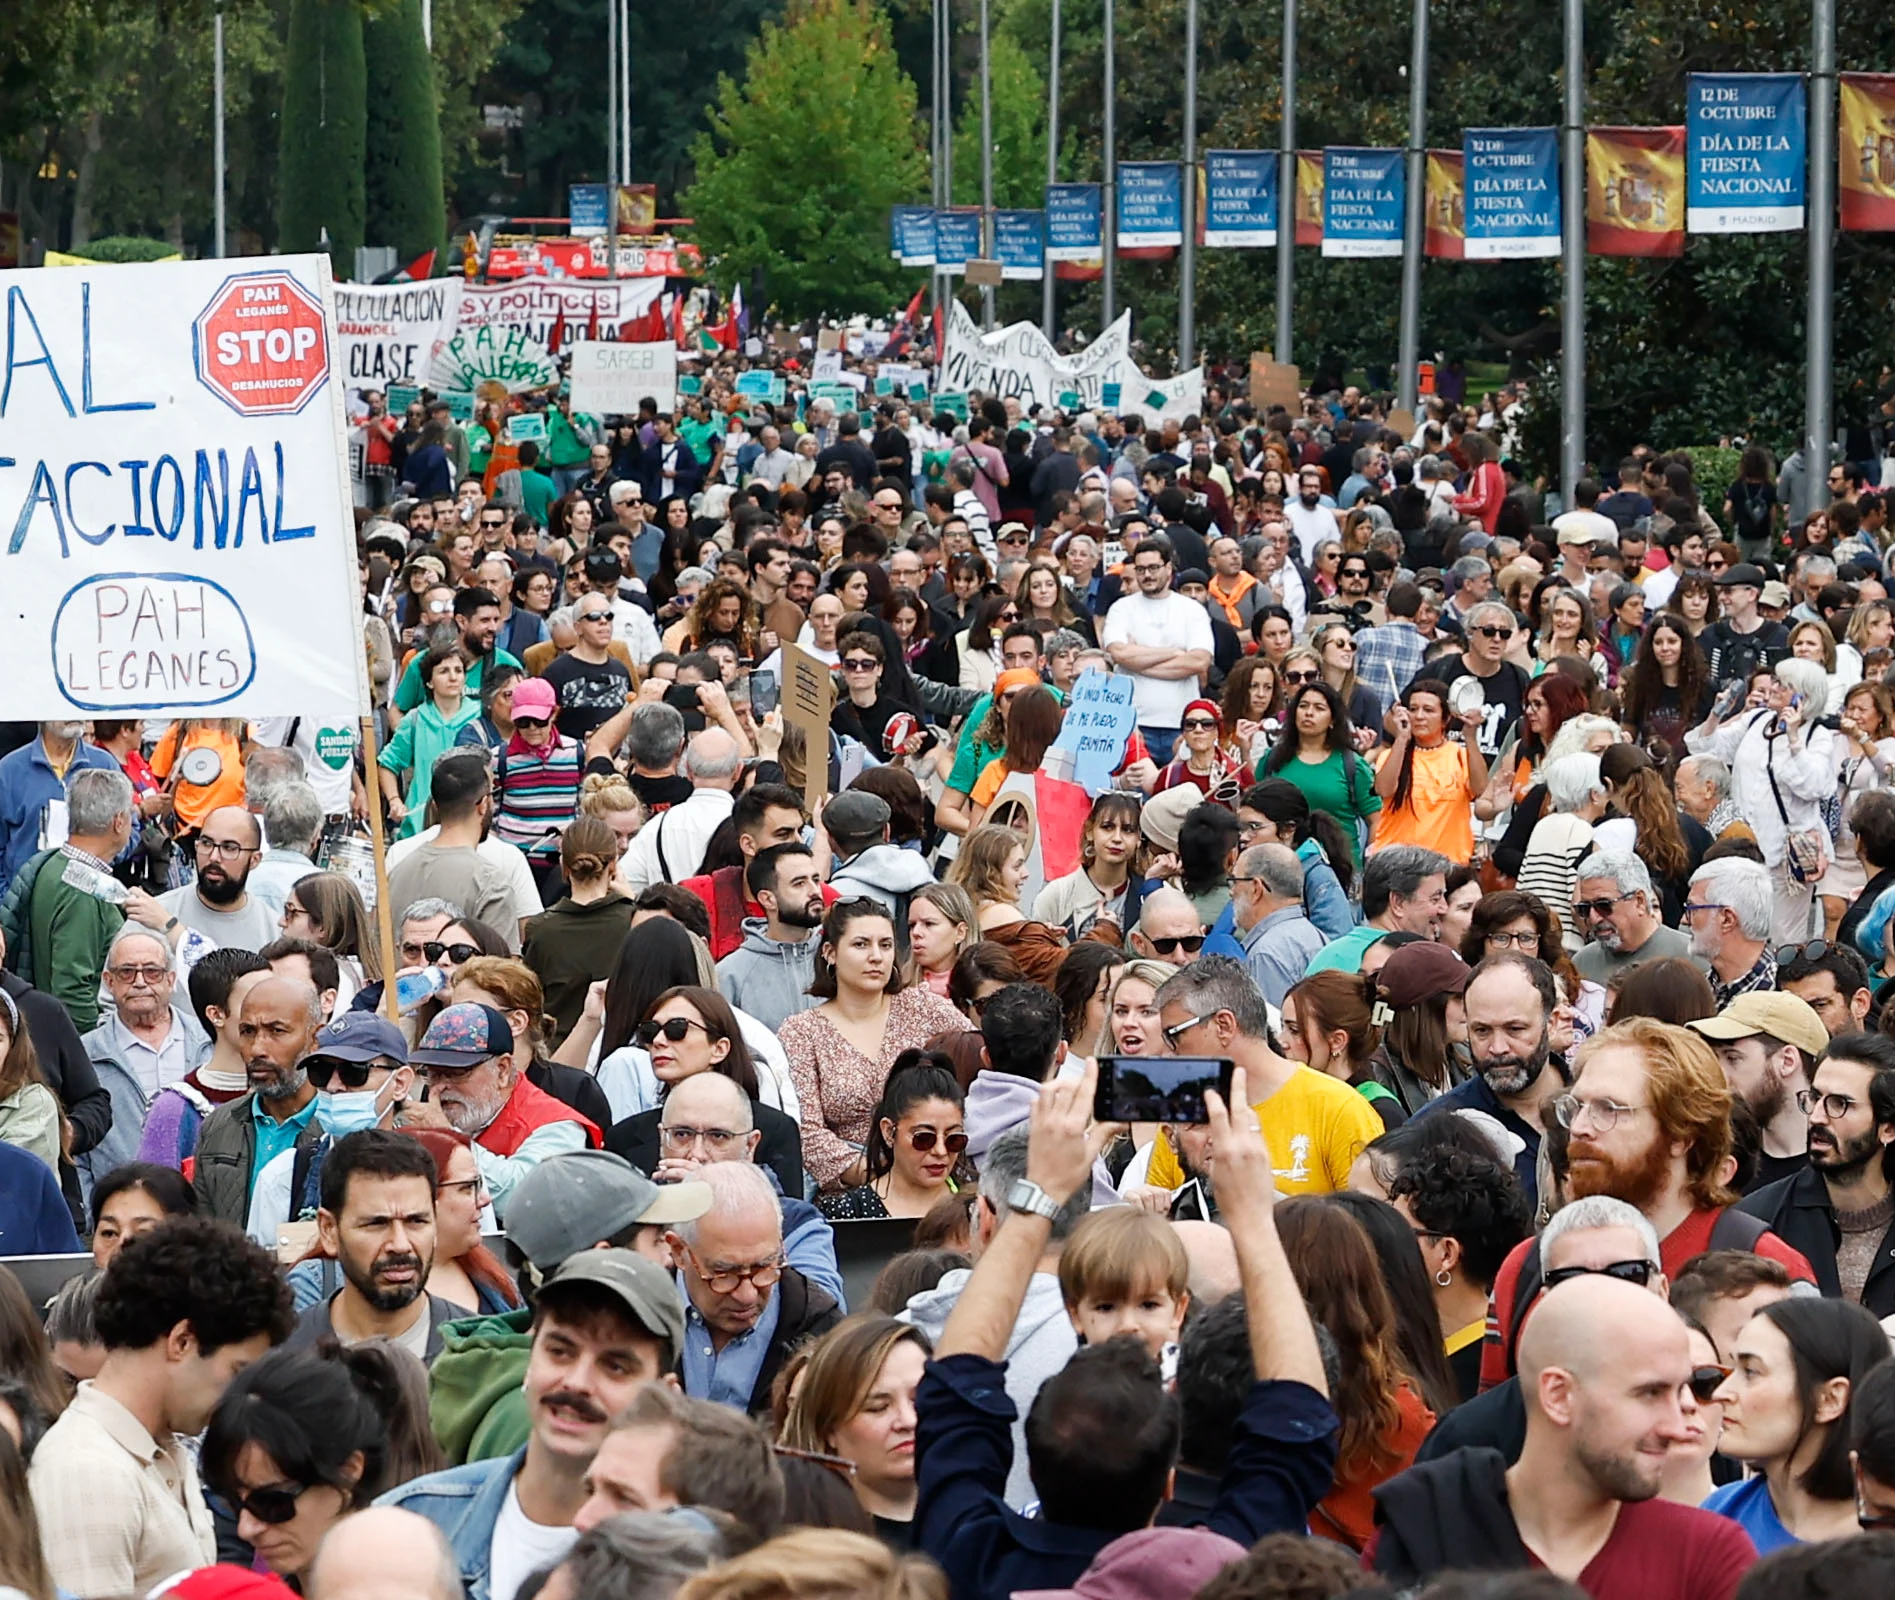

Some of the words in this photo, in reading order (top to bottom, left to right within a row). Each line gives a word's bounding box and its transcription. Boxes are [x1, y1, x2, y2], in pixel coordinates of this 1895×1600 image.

[1700, 88, 1713, 102] 12
[1717, 88, 1739, 101] DE
[1700, 105, 1776, 120] OCTUBRE
[1485, 140, 1503, 151] DE
[1700, 133, 1733, 152] DÍA
[1737, 136, 1763, 151] DE
[1766, 135, 1791, 151] LA
[1472, 154, 1535, 167] OCTUBRE
[1700, 157, 1762, 173] FIESTA
[1330, 169, 1385, 179] OCTUBRE
[1473, 177, 1500, 192] DÍA
[1503, 179, 1524, 191] DE
[1526, 178, 1547, 191] LA
[1700, 178, 1797, 194] NACIONAL
[1356, 189, 1374, 201] DE
[1375, 190, 1394, 201] LA
[1213, 201, 1250, 211] FIESTA
[1330, 204, 1374, 216] FIESTA
[1473, 197, 1524, 210] FIESTA
[1123, 216, 1175, 226] NACIONAL
[1213, 213, 1272, 223] NACIONAL
[1330, 219, 1398, 231] NACIONAL
[1472, 213, 1554, 227] NACIONAL
[1732, 216, 1776, 225] MADRID
[243, 286, 280, 302] PAH
[235, 304, 289, 318] LEGANÉS
[481, 297, 495, 313] Y
[216, 327, 317, 366] STOP
[350, 342, 419, 381] CLASE
[231, 377, 303, 391] DESAHUCIOS
[95, 584, 205, 643] PAH
[69, 648, 240, 691] LEGANES
